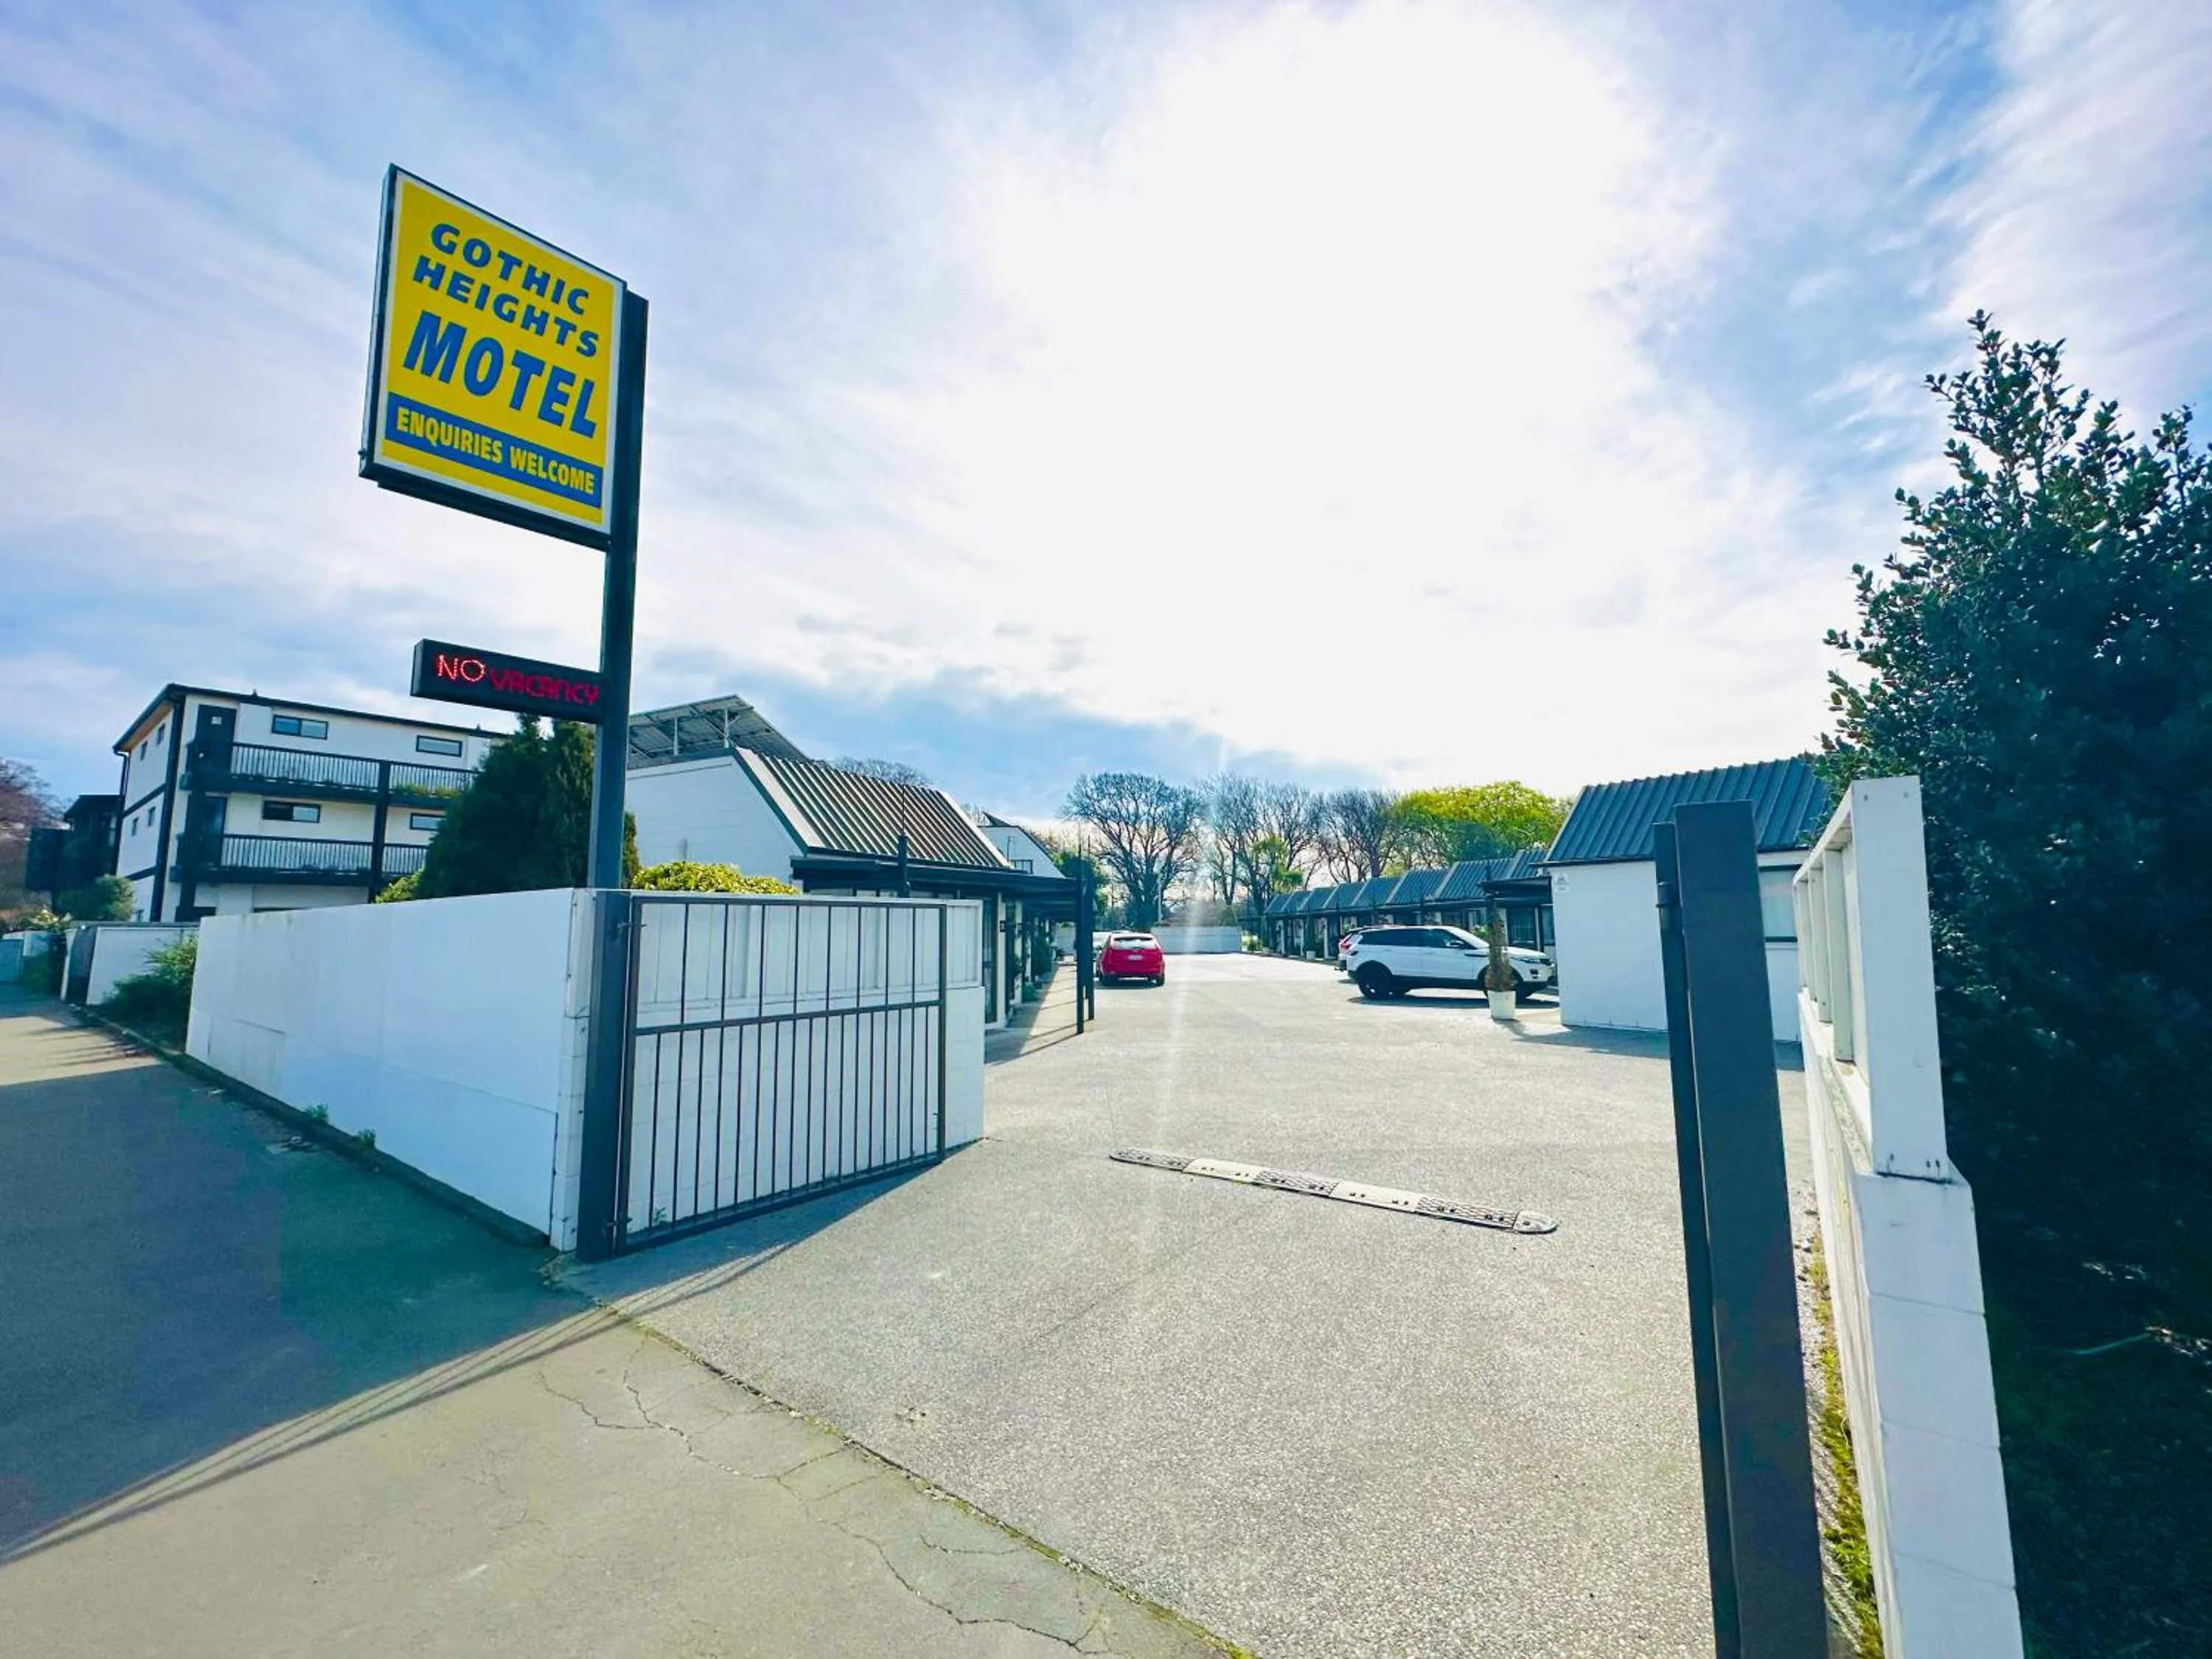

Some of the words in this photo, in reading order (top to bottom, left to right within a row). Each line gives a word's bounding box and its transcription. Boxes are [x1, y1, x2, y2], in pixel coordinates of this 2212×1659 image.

[412, 254, 600, 358] HEIGHTS
[430, 223, 589, 315] GOTHIC
[403, 310, 597, 439] MOTEL
[397, 406, 503, 465] ENQUIRIES
[509, 445, 595, 495] WELCOME
[437, 654, 486, 682] NO
